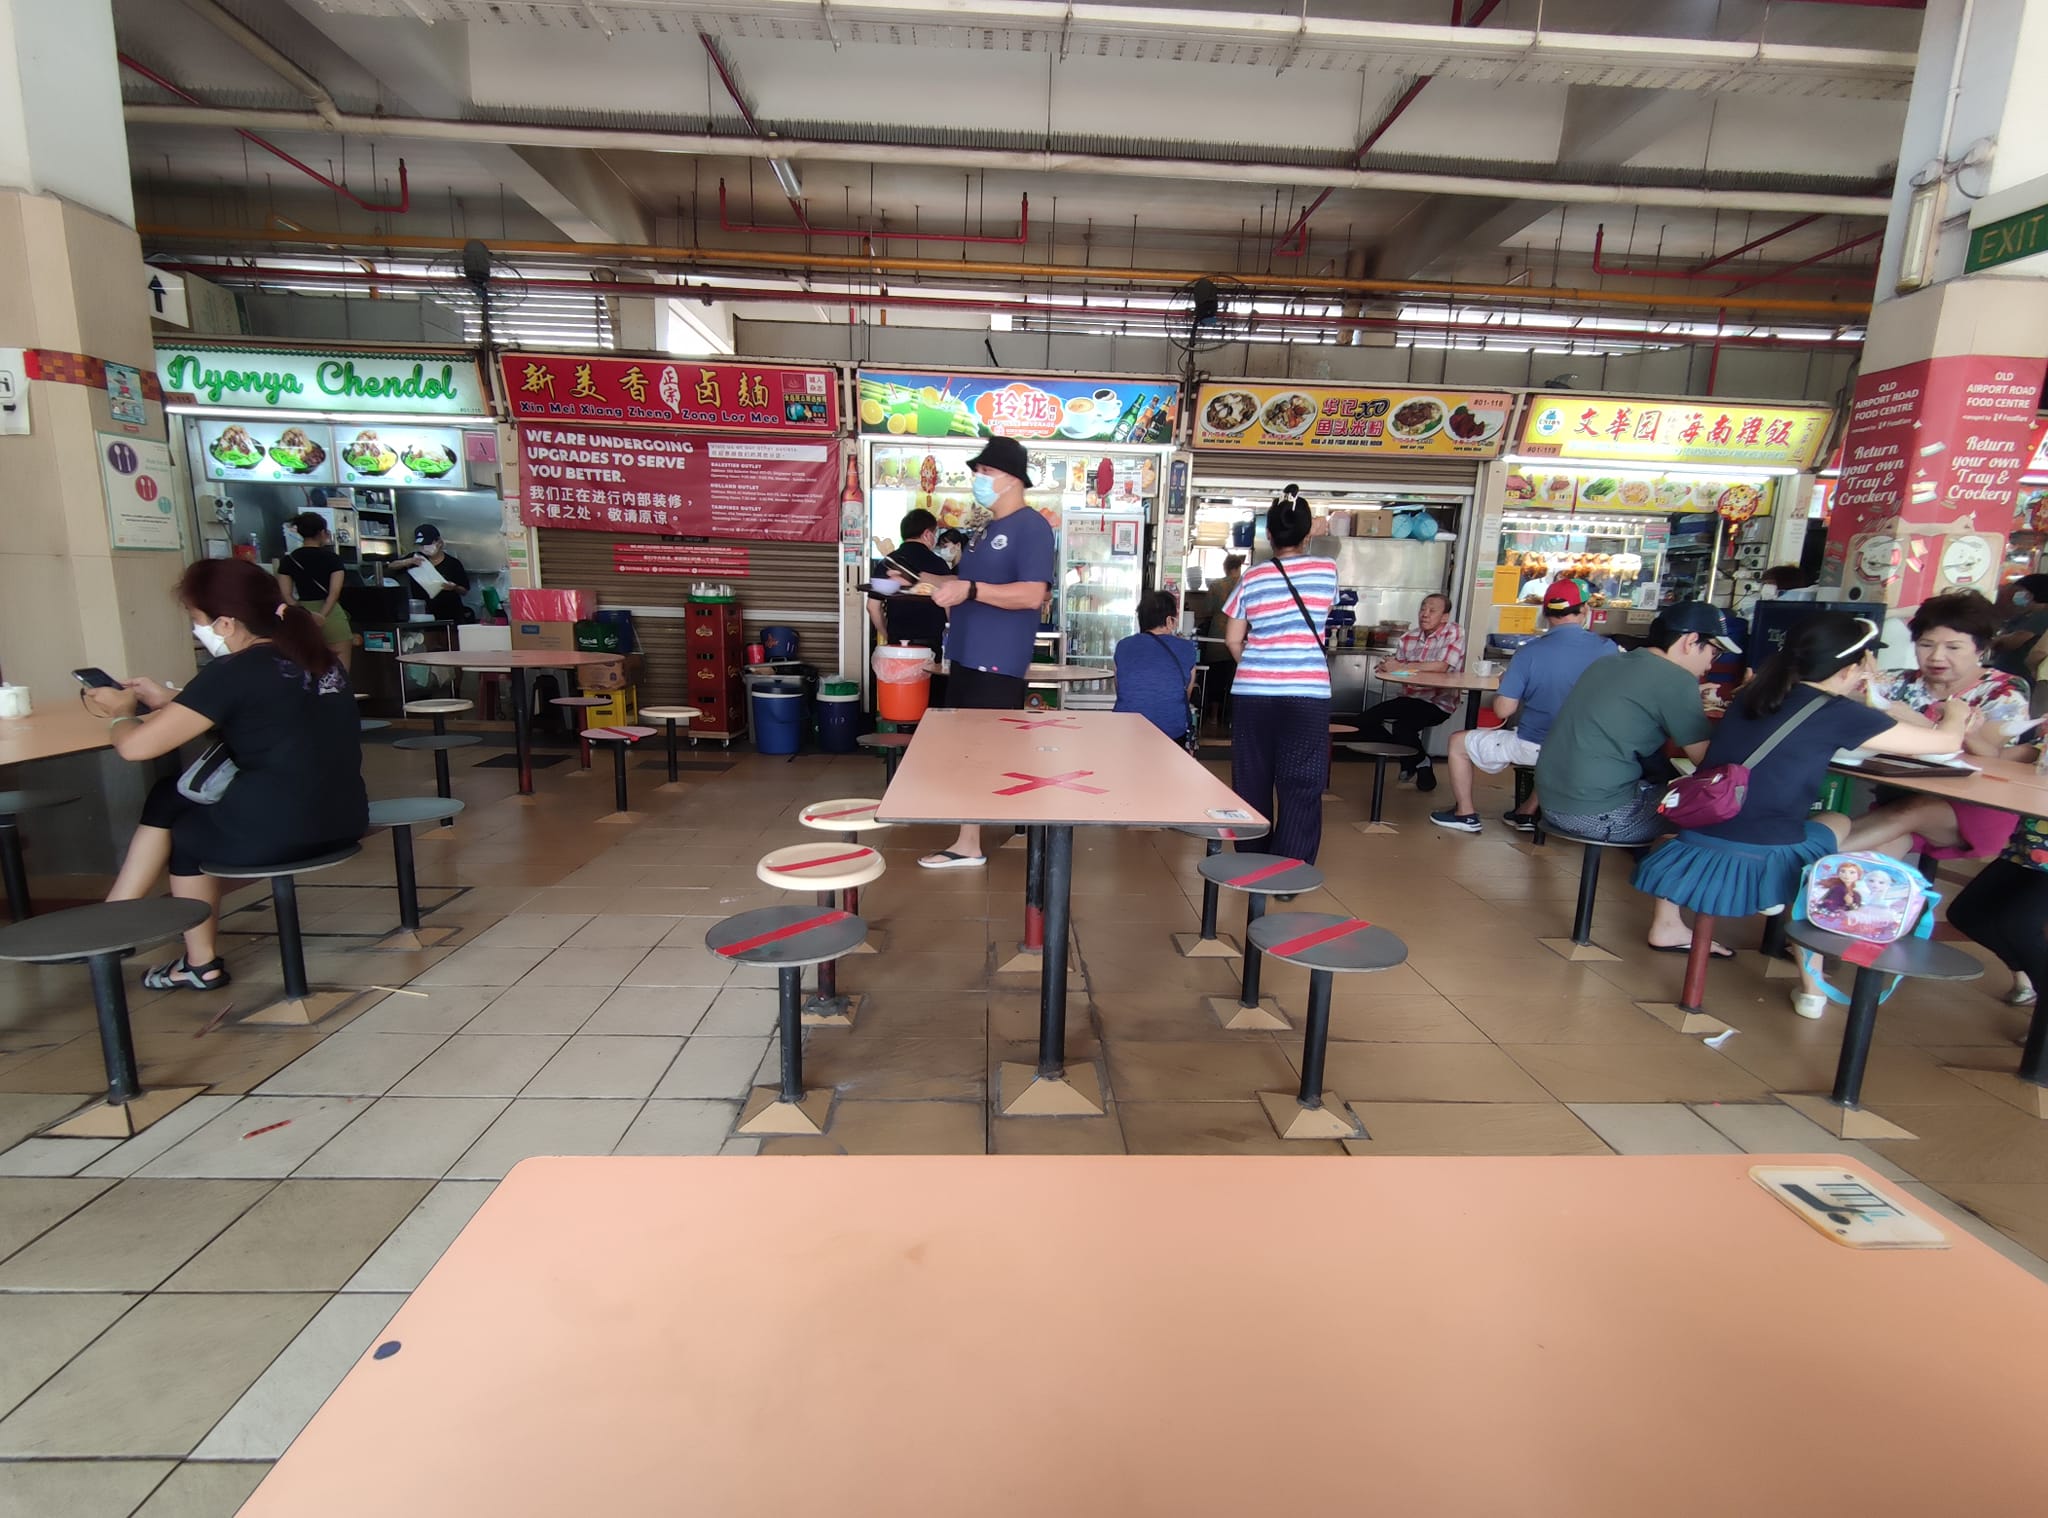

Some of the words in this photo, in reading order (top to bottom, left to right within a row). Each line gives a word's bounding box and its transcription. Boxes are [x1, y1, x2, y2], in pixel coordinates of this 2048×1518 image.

[1978, 214, 2046, 263] EXIT
[168, 354, 303, 404] Nyonya
[317, 360, 457, 399] Chendol
[521, 362, 649, 404] 新美香
[664, 367, 680, 403] 正宗
[1878, 381, 1897, 392] OLD
[1994, 371, 2014, 381] OLD
[1854, 394, 1892, 409] AIRPORT
[1892, 389, 1919, 402] ROAD
[1966, 383, 2009, 394] AIRPORT
[2008, 385, 2037, 396] ROAD
[520, 401, 545, 412] Xin
[550, 403, 576, 414] Mei
[581, 405, 622, 418] Xiang
[628, 405, 672, 420] Zheng
[682, 409, 716, 423] Zong
[722, 411, 745, 422] Lor
[750, 413, 779, 424] Mee
[994, 392, 1048, 420] 玲珑
[1854, 409, 1879, 421] FOOD
[1879, 402, 1914, 416] CENTRE
[1966, 397, 1994, 407] FOOD
[1995, 398, 2031, 409] CENTRE
[526, 429, 552, 443] WE
[554, 432, 586, 446] ARE
[589, 434, 694, 453] UNDERGOING
[1854, 443, 1899, 460] Return
[1965, 435, 2016, 453] Return
[527, 447, 609, 464] UPGRADES
[612, 452, 634, 466] TO
[637, 455, 686, 470] SERVE
[1840, 463, 1873, 479] your
[1875, 458, 1905, 472] own
[1951, 456, 1984, 471] your
[1988, 456, 2021, 470] own
[528, 464, 561, 478] YOU
[565, 467, 626, 483] BETTER.
[1846, 476, 1881, 495] Tray
[1883, 472, 1895, 485] &
[1957, 468, 1995, 489] Tray
[1997, 470, 2010, 485] &
[529, 485, 693, 509] 我们正在进行内部装修，
[1838, 488, 1898, 506] Crockery
[1947, 484, 2013, 505] Crockery
[530, 502, 679, 525] 不便之处，敬请原谅。
